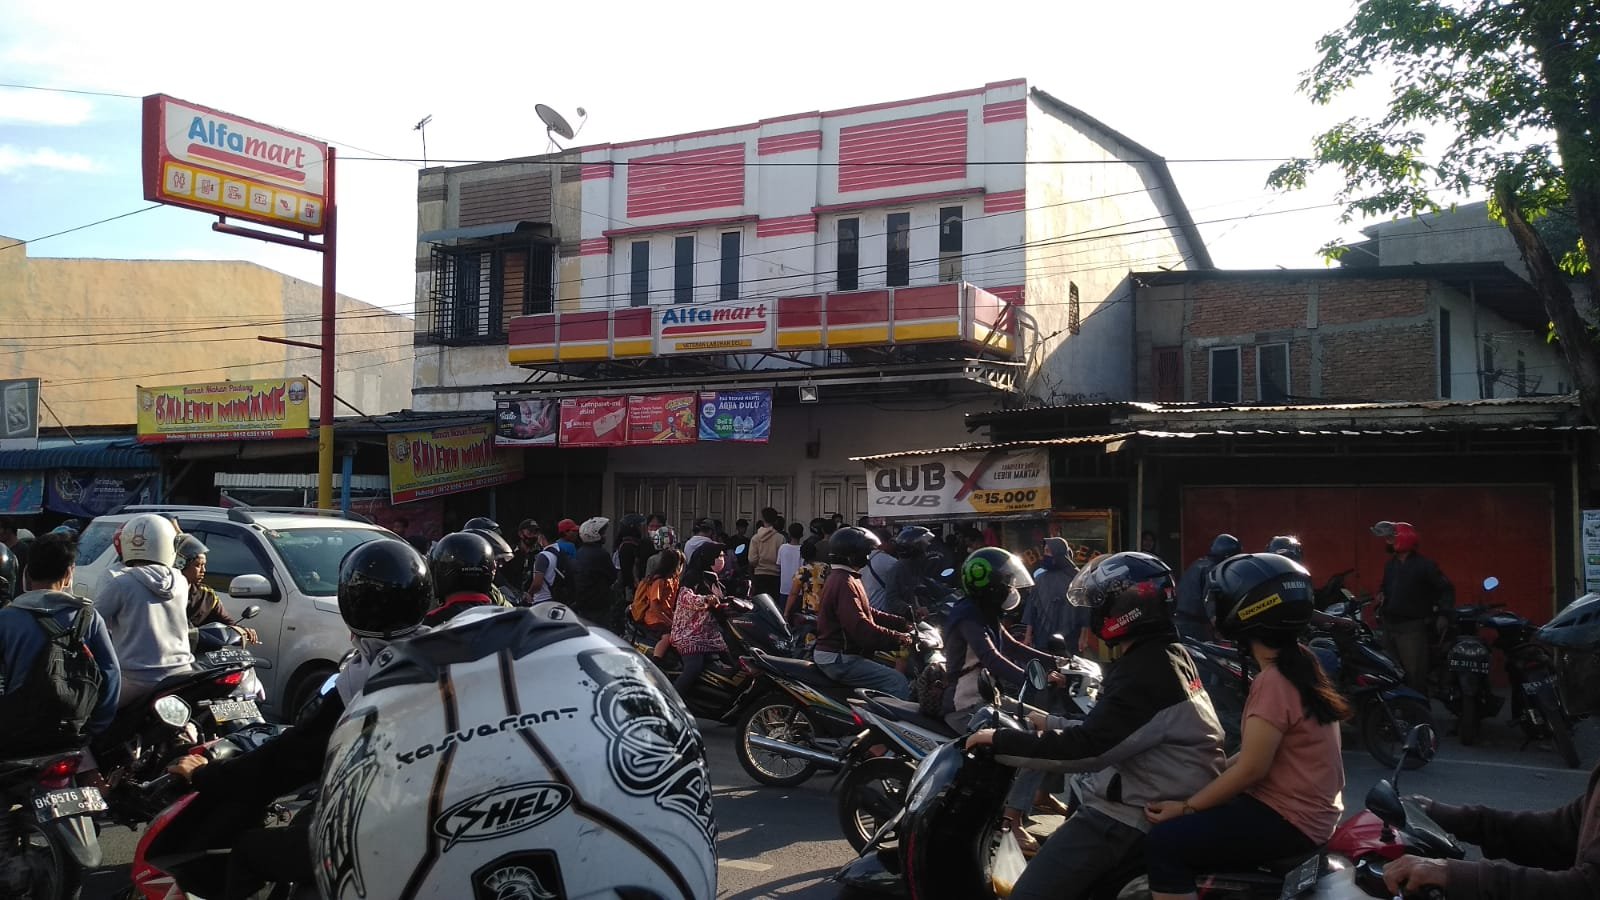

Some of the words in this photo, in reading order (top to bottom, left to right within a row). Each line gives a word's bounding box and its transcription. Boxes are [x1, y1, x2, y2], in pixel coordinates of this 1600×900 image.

[187, 116, 306, 168] Alfamart
[662, 304, 767, 324] Alfamart
[155, 392, 214, 425] SALERO
[217, 381, 286, 423] MINANG
[718, 402, 737, 410] AQUA
[739, 401, 759, 409] DULU
[874, 462, 945, 492] CLUB
[993, 471, 1012, 480] LEBIH
[1013, 470, 1040, 479] MANTAP
[876, 495, 941, 508] CLUB
[34, 792, 52, 809] BK
[51, 791, 78, 804] 6576
[444, 789, 554, 849] SHEL
